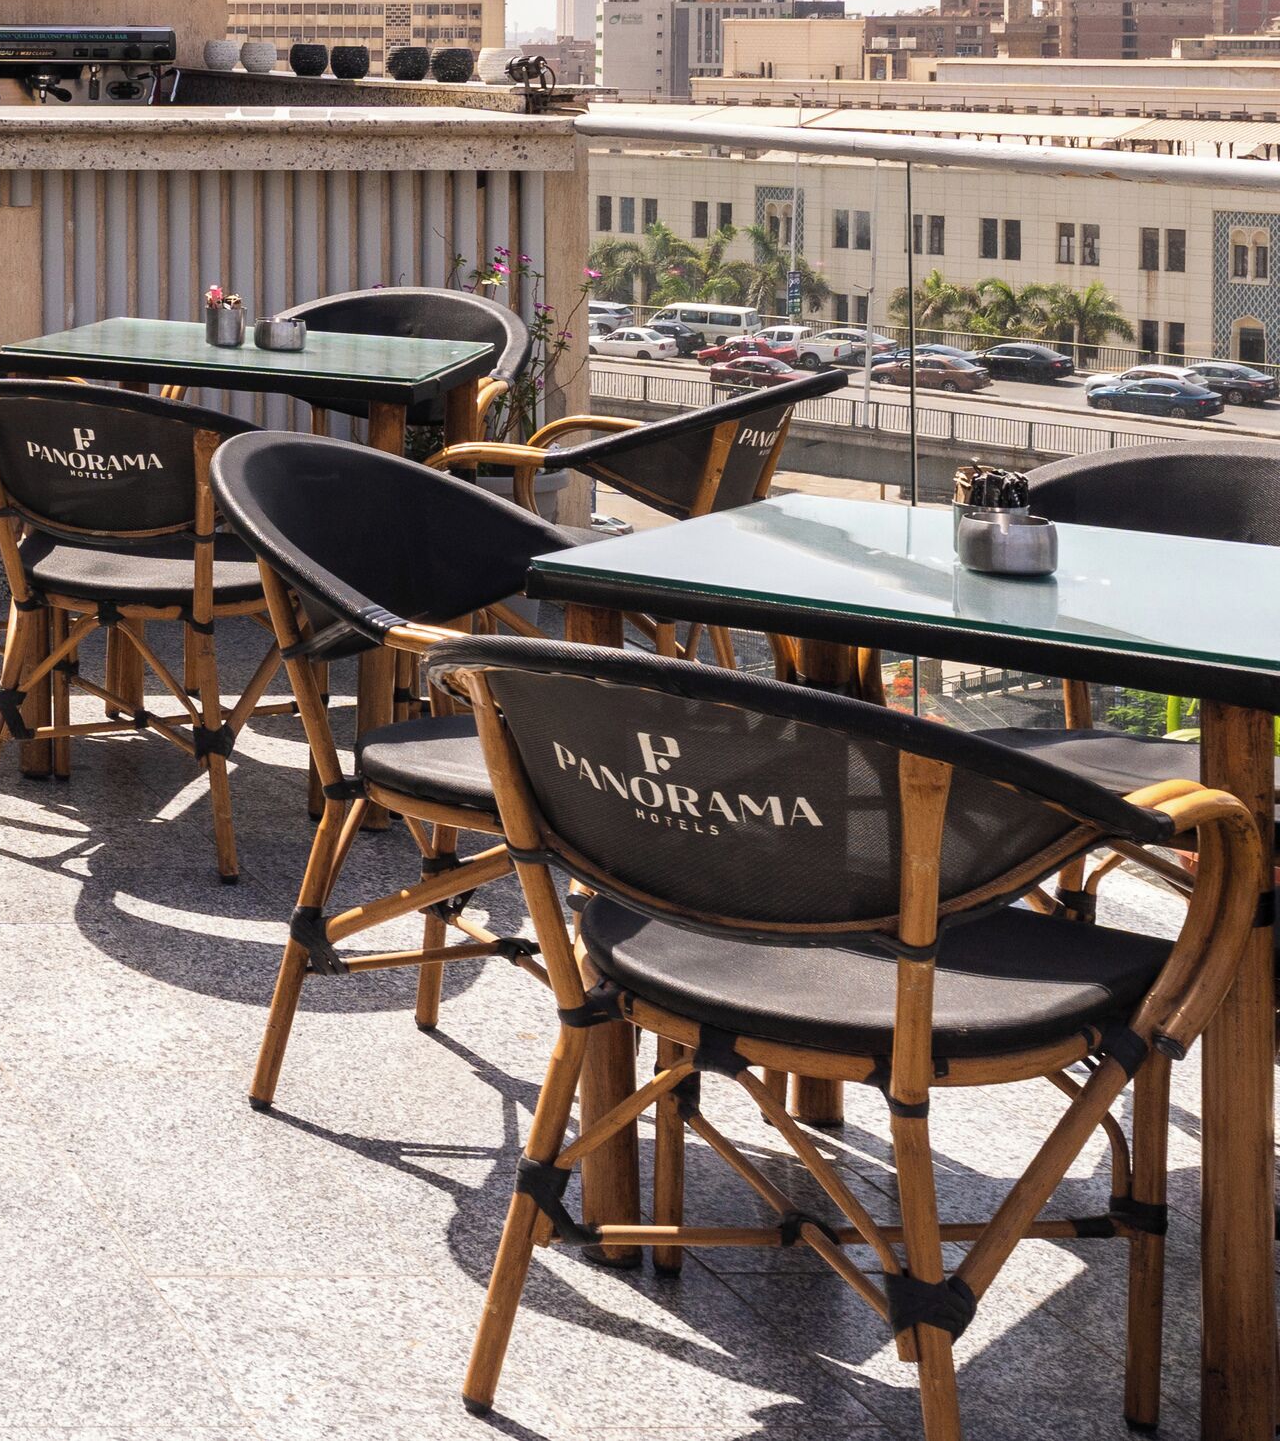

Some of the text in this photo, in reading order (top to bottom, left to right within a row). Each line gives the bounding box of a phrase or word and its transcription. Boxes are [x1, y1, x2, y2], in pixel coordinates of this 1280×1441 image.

[26, 440, 164, 472] PANORAMA
[69, 469, 114, 480] HOTELS
[552, 740, 824, 828] PANORAMA
[634, 806, 721, 836] HOTELS
